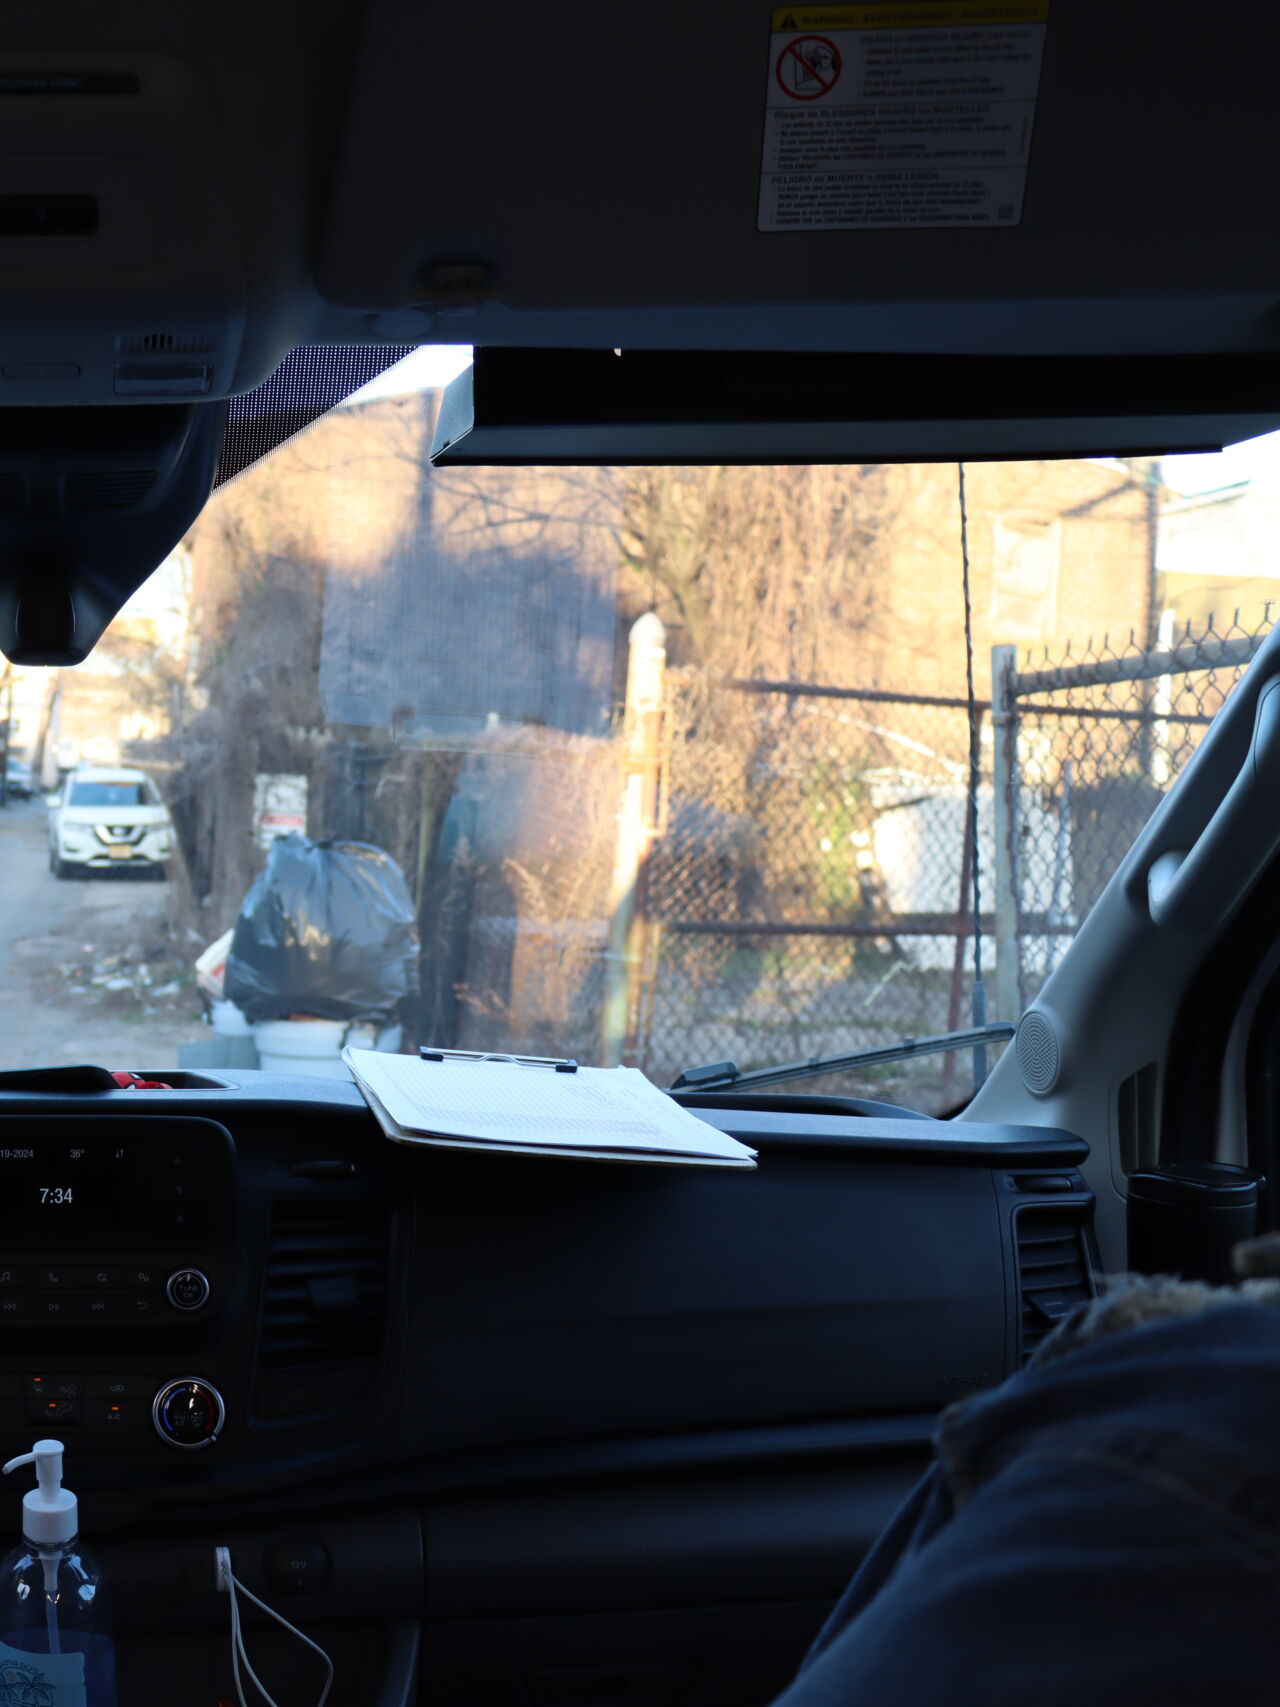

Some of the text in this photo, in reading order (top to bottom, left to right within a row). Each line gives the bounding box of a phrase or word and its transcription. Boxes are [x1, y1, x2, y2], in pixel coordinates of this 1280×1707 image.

[801, 14, 853, 25] WARNING
[860, 34, 892, 45] DEATH
[774, 111, 806, 121] Risque
[820, 108, 877, 118] BLESSURES
[878, 107, 917, 116] GRAVES
[771, 175, 813, 185] PELIGRO
[827, 174, 866, 184] MUERTE
[875, 173, 904, 183] SERIA
[175, 1184, 183, 1195] 5
[39, 1187, 74, 1205] 7:34
[290, 1559, 307, 1569] 12V
